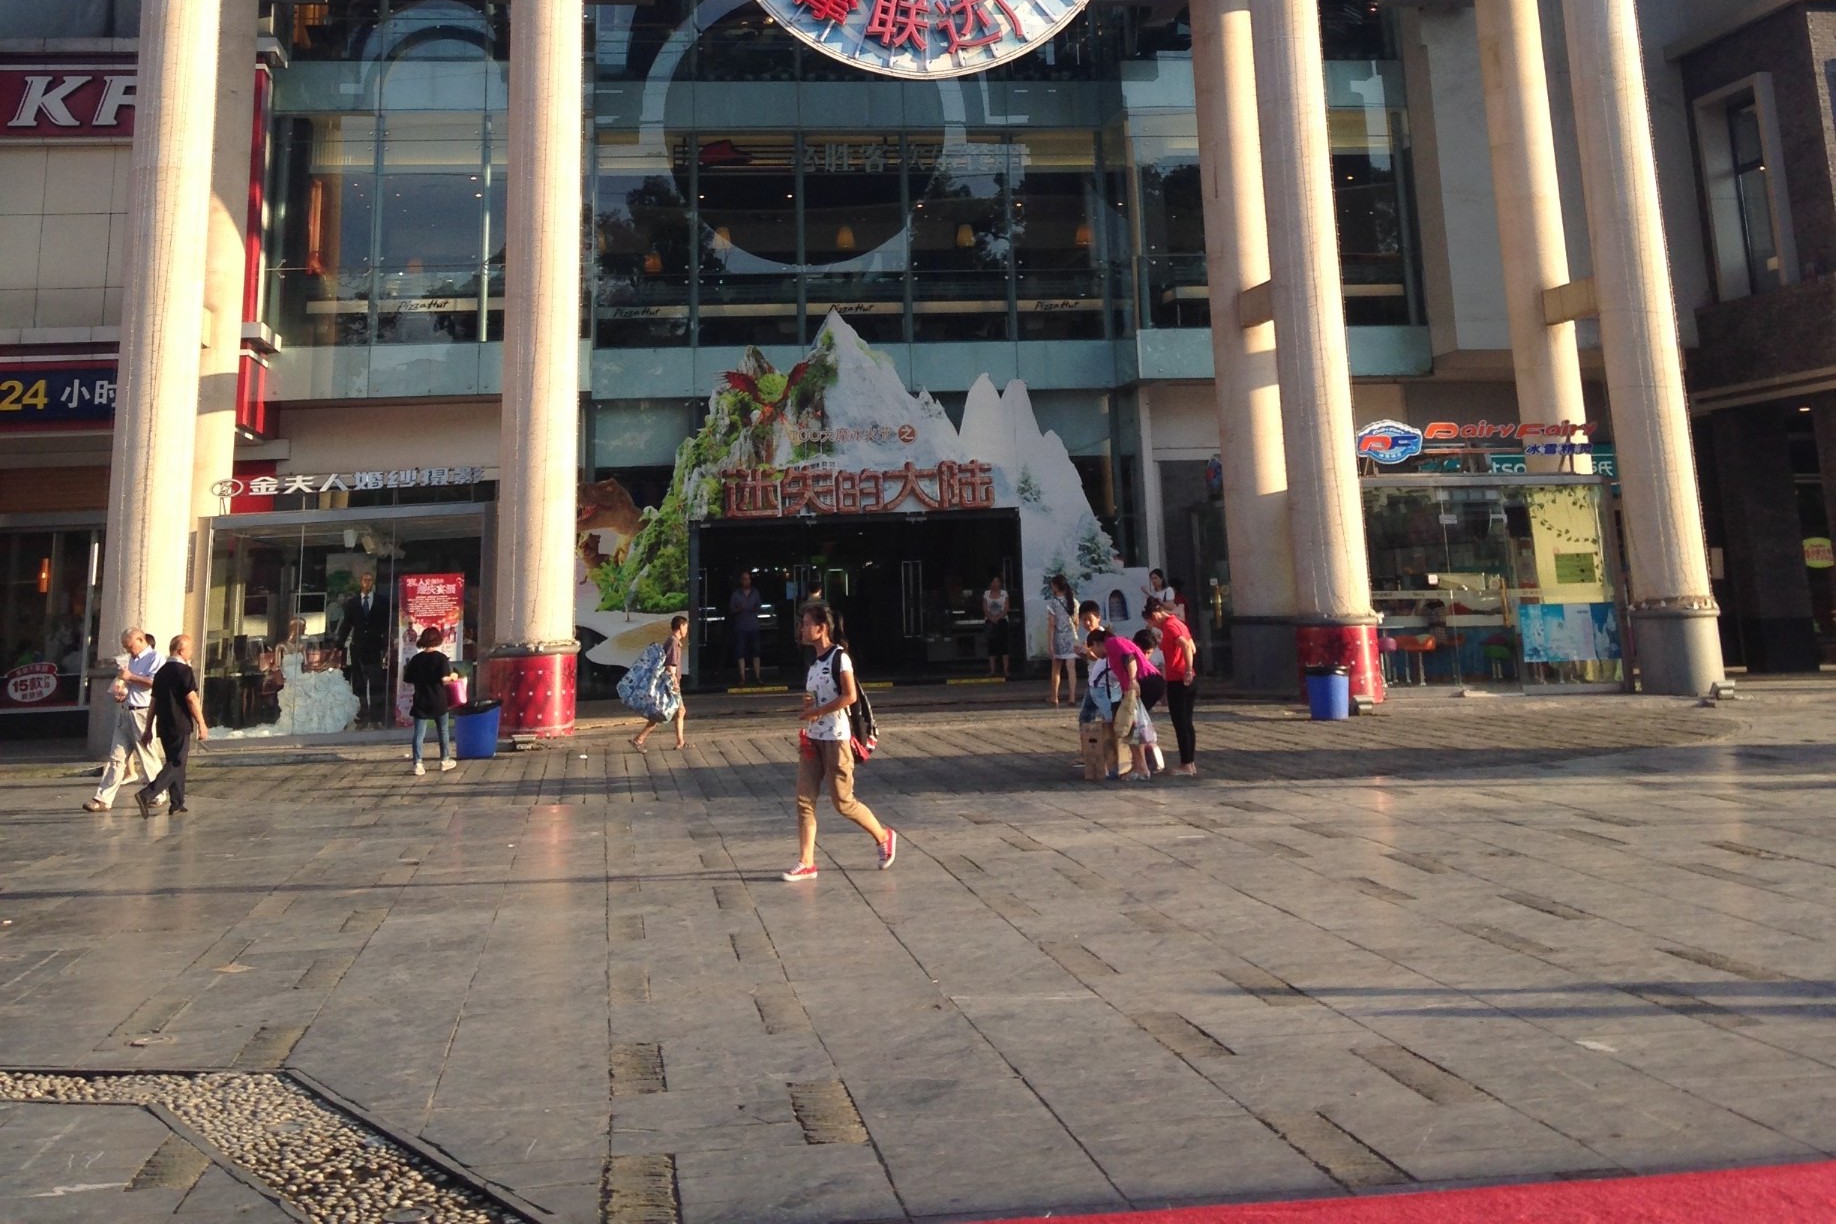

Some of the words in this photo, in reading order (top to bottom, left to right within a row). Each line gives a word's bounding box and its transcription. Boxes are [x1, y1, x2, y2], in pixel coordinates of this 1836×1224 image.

[0, 379, 48, 410] 24
[1424, 419, 1515, 439] Dairy
[1515, 418, 1598, 440] Fairy
[248, 466, 485, 495] 金夫人婚纱摄影
[721, 459, 995, 518] 迷失的大陆
